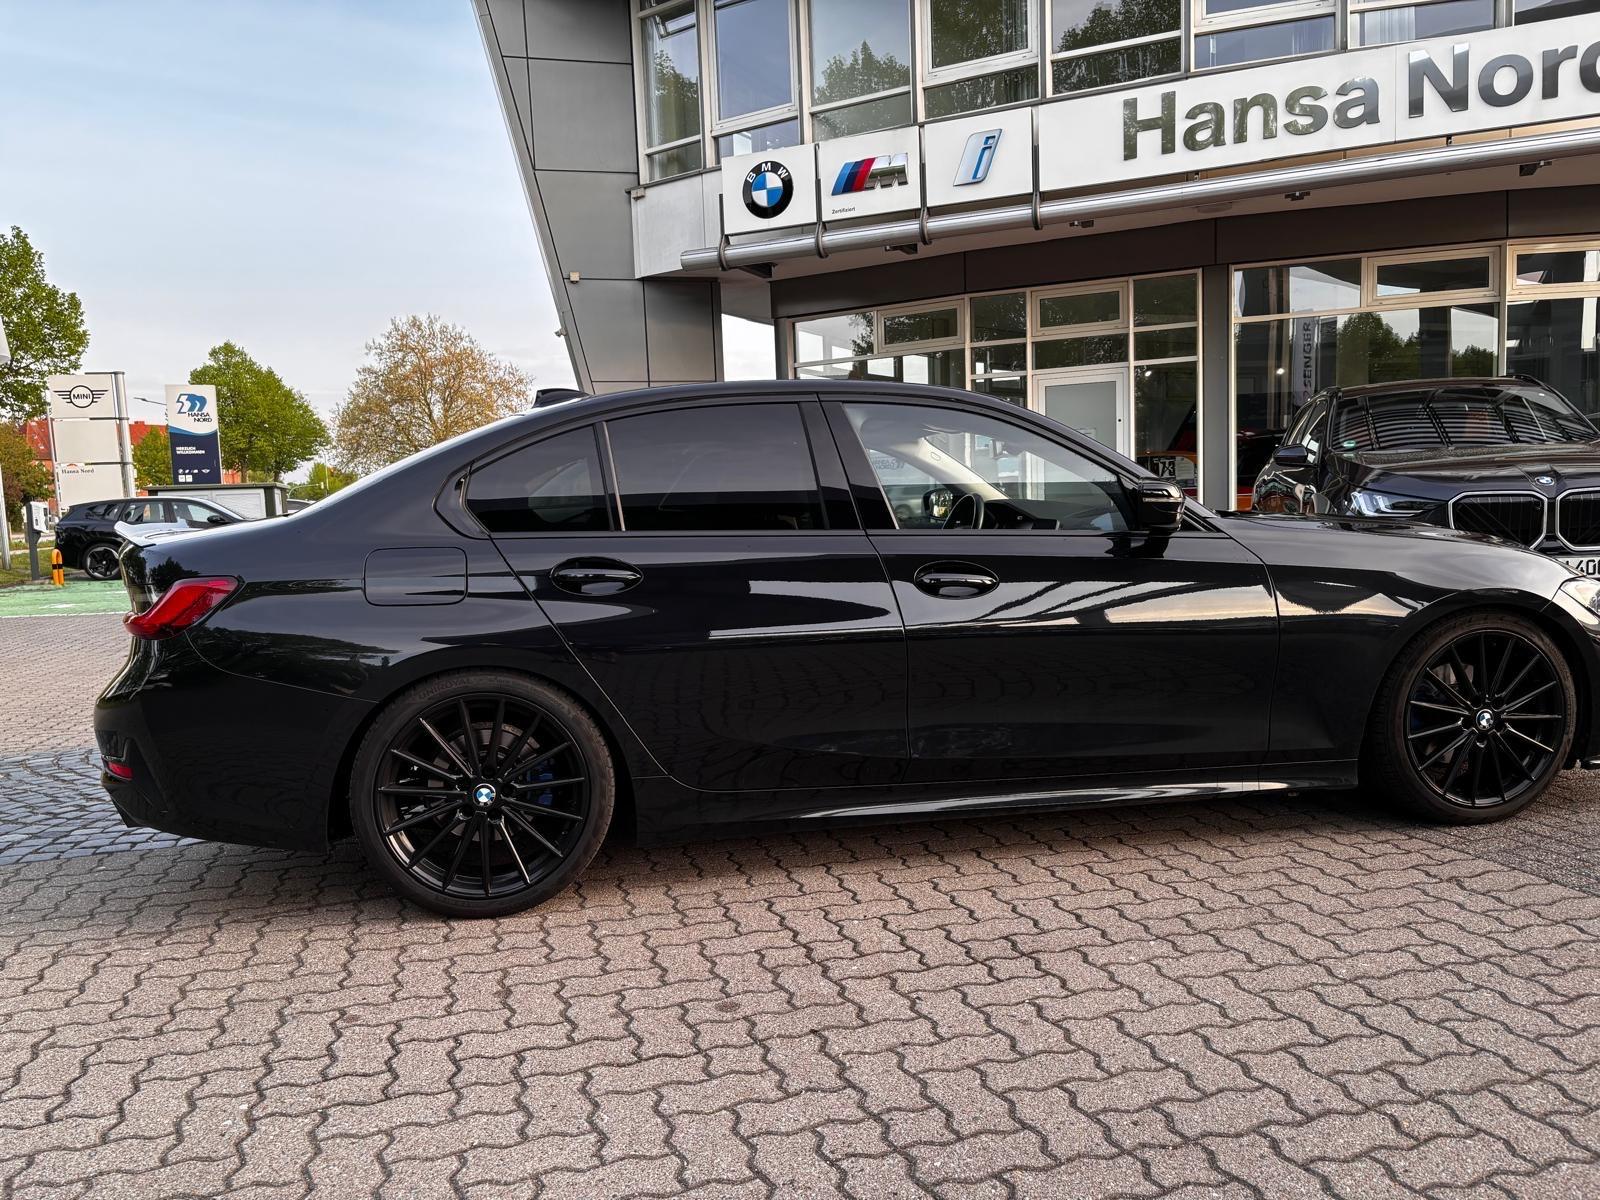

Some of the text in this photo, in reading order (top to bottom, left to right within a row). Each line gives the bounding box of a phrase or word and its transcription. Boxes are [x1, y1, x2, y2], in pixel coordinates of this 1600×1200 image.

[1123, 77, 1380, 161] Hansa
[746, 162, 789, 183] BMW
[1303, 322, 1312, 388] SENGER
